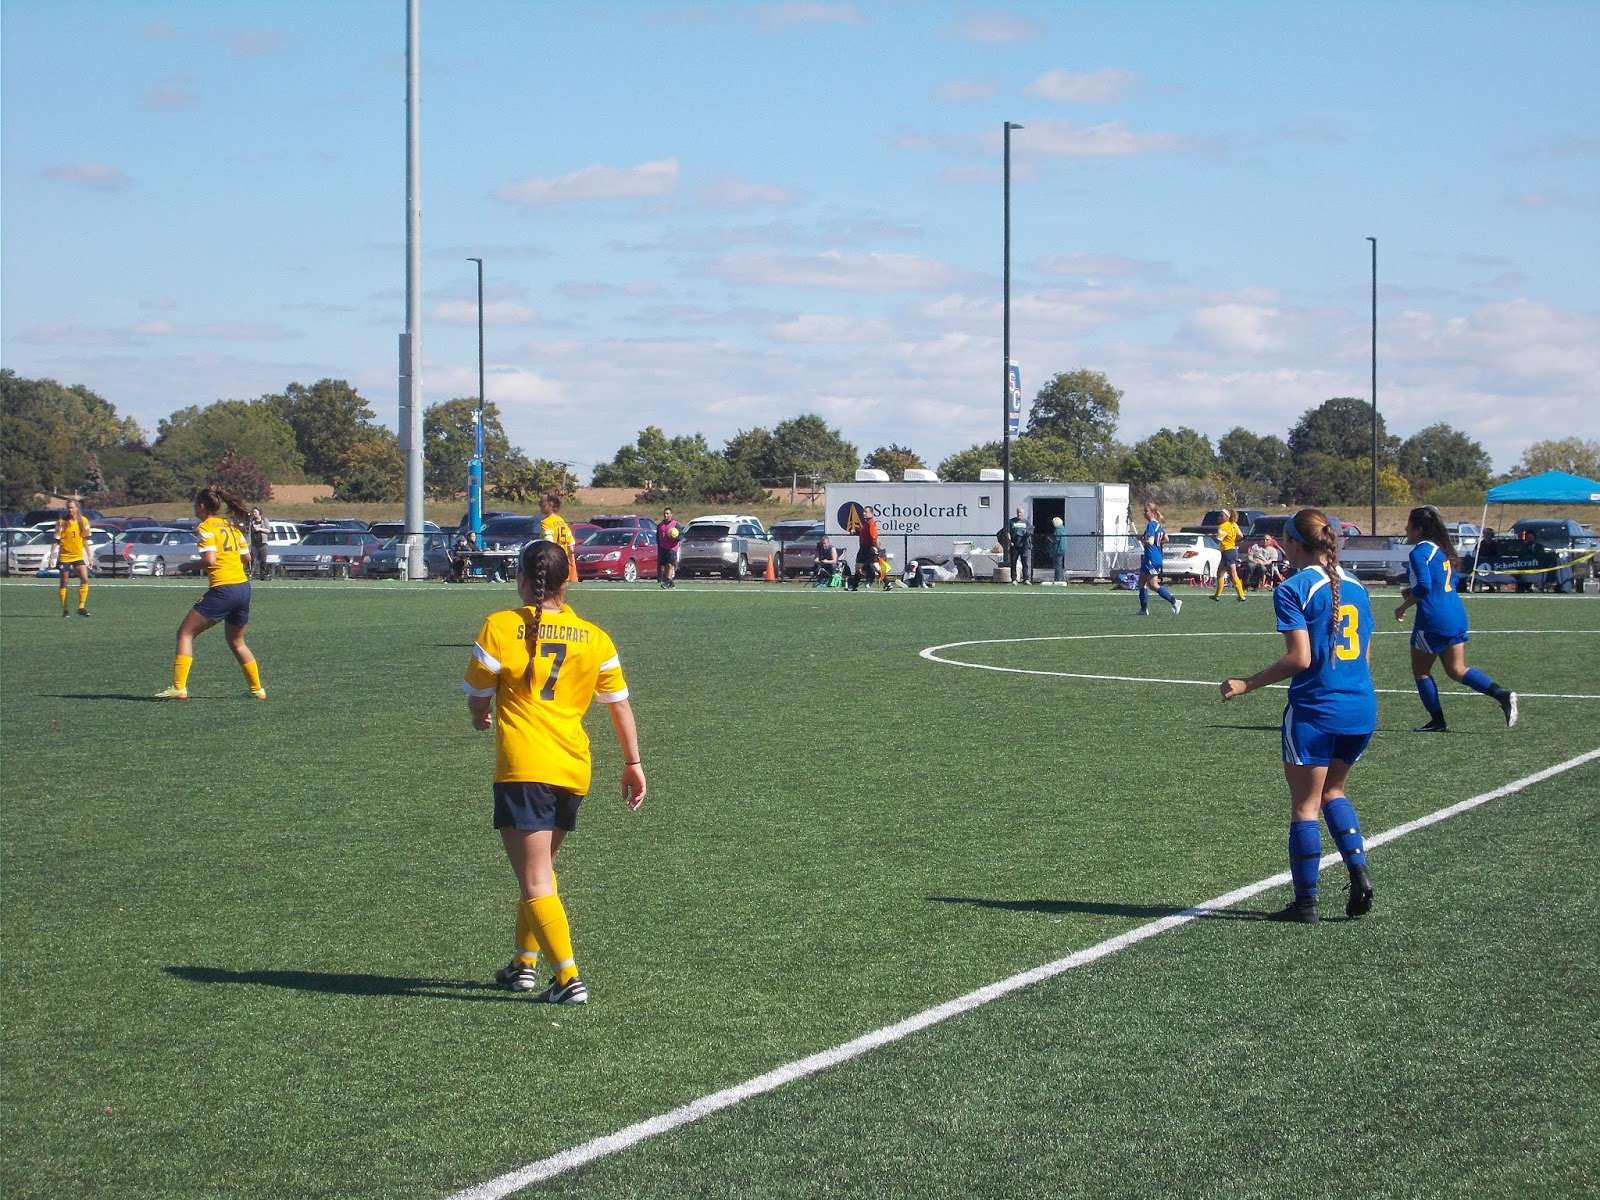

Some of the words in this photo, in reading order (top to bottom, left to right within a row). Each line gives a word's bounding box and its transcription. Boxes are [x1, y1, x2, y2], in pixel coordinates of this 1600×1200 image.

[873, 503, 968, 517] Schoolcraft
[71, 531, 76, 539] 3
[220, 527, 238, 552] 21
[1494, 559, 1539, 569] Schoolcraft
[516, 624, 589, 643] SOOLCRAFT
[1336, 604, 1361, 661] 3
[540, 642, 567, 700] 7
